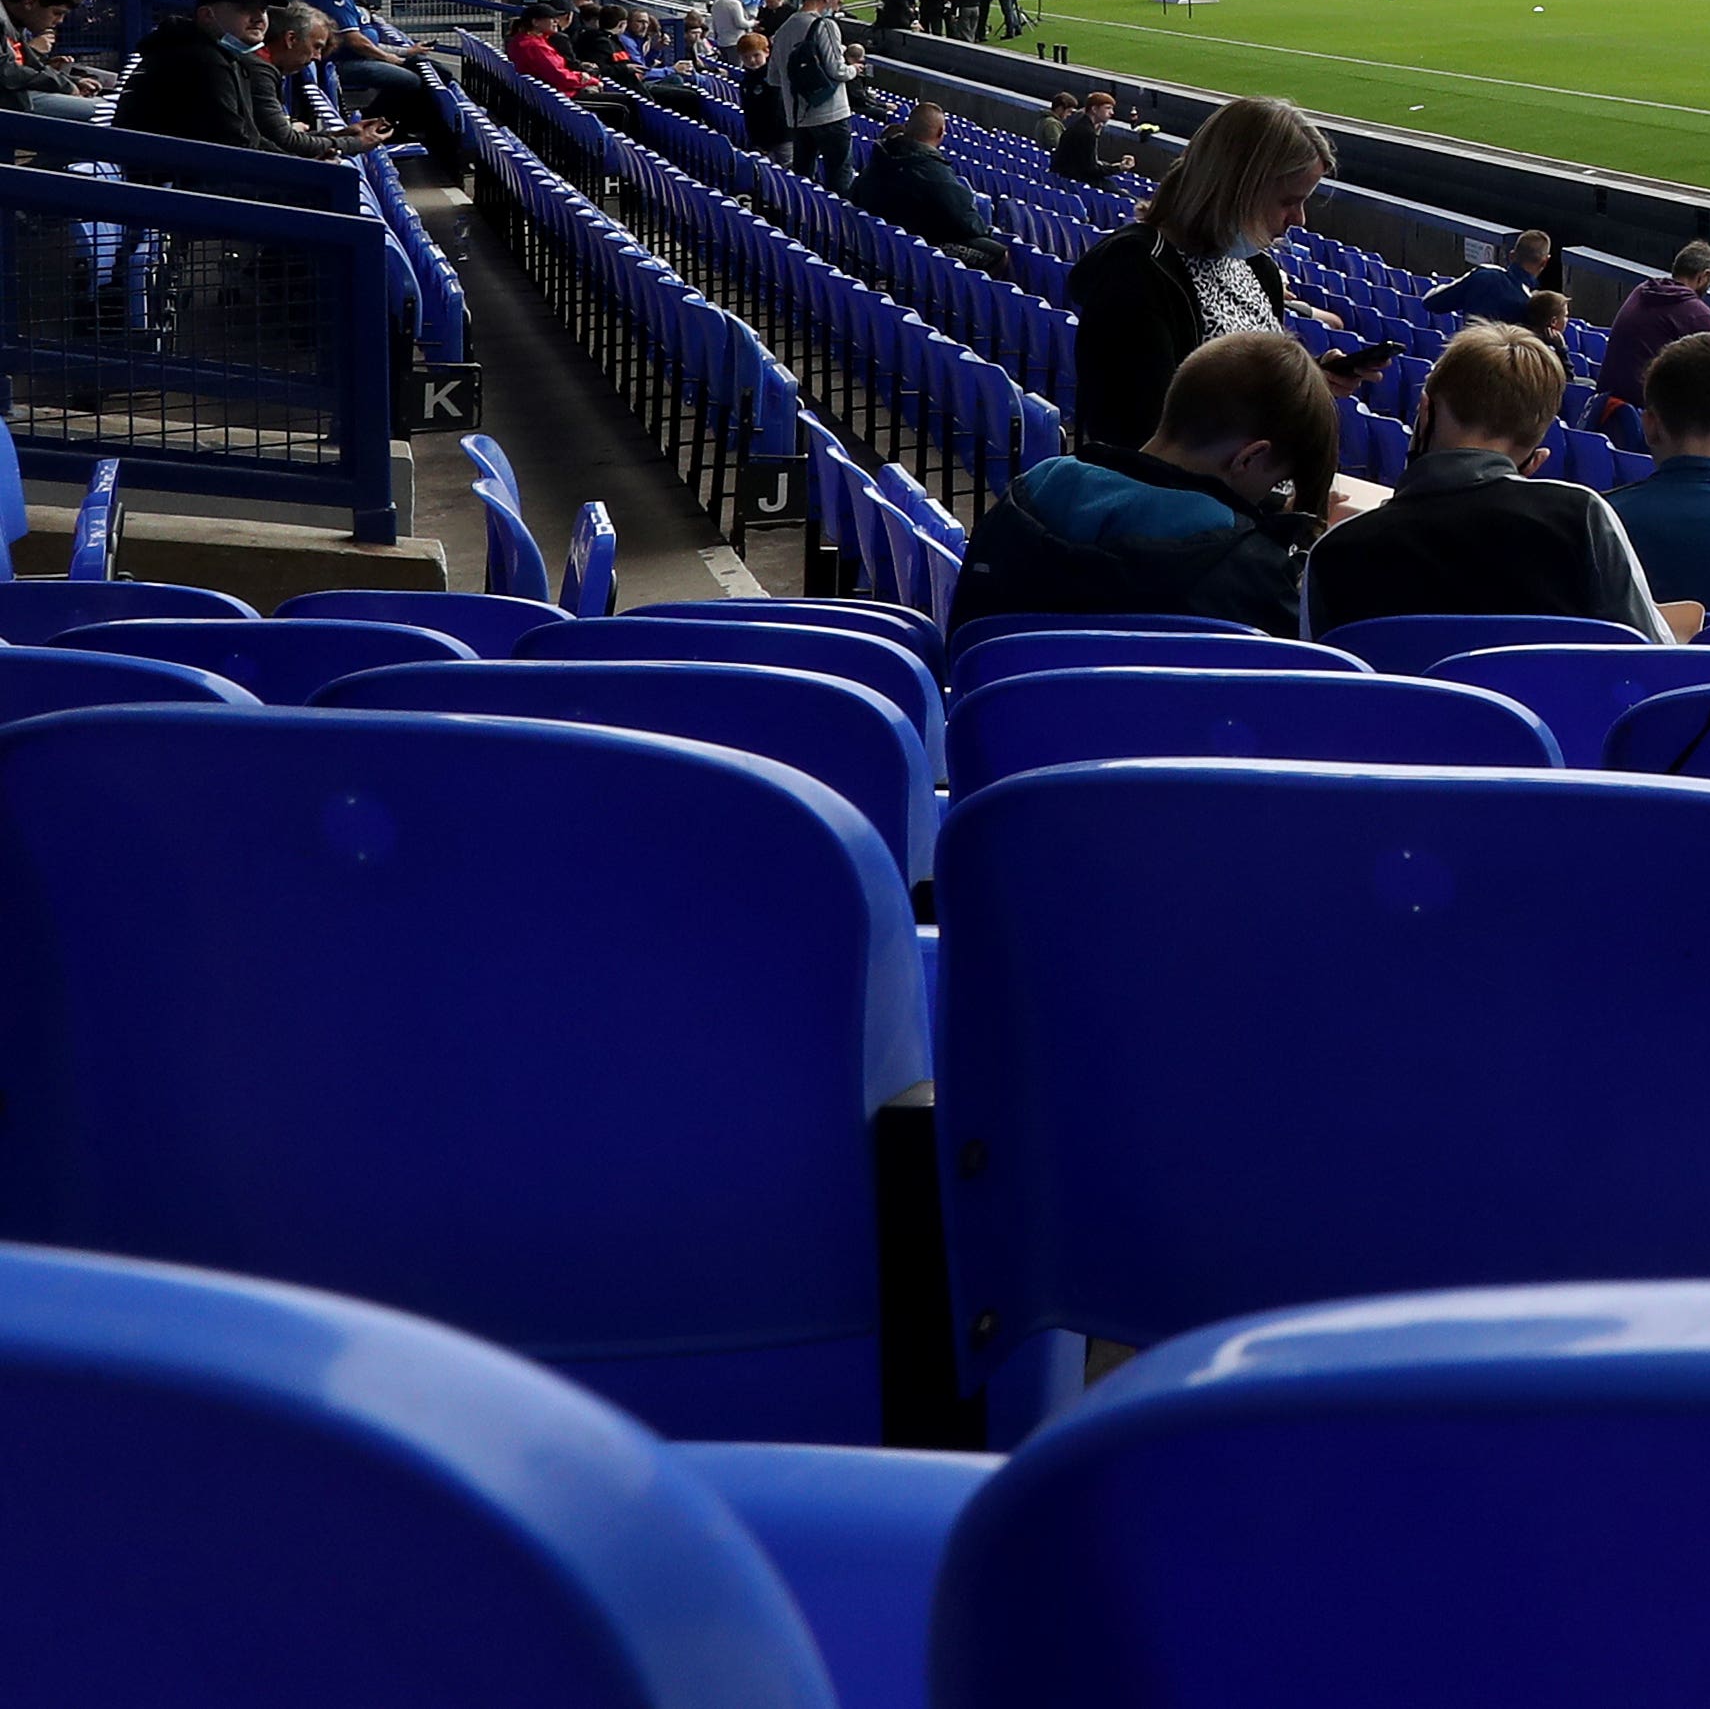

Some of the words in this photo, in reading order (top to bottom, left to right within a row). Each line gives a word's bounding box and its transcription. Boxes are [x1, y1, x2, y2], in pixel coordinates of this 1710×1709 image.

[604, 176, 620, 194] H
[422, 380, 465, 419] K
[757, 472, 790, 514] J
